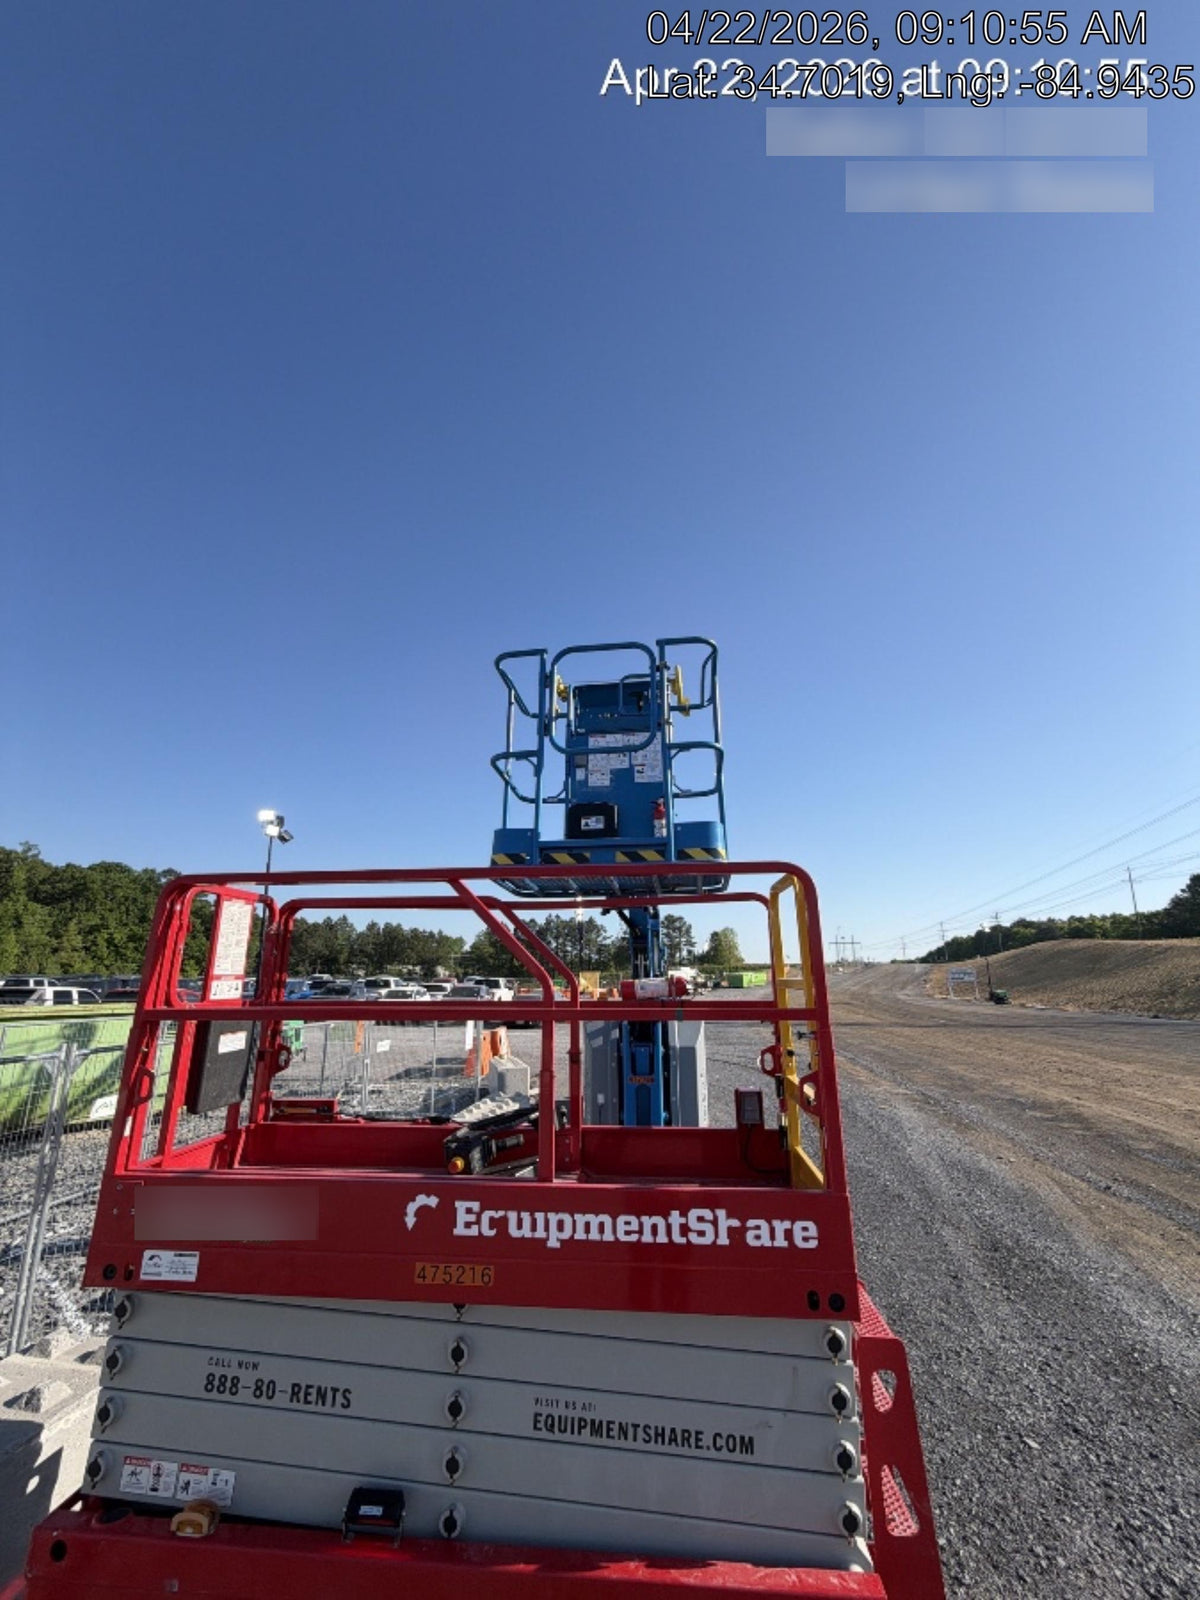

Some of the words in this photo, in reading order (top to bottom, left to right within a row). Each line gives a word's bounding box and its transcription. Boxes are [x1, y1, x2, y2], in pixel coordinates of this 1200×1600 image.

[416, 1264, 493, 1286] 475216
[208, 1356, 232, 1368] CALL
[237, 1359, 261, 1371] NOW
[204, 1372, 352, 1409] 888-80-RENTS
[534, 1397, 559, 1409] VISIT
[565, 1400, 577, 1410] US
[533, 1412, 754, 1455] EQUIPMENTSHARE.COM
